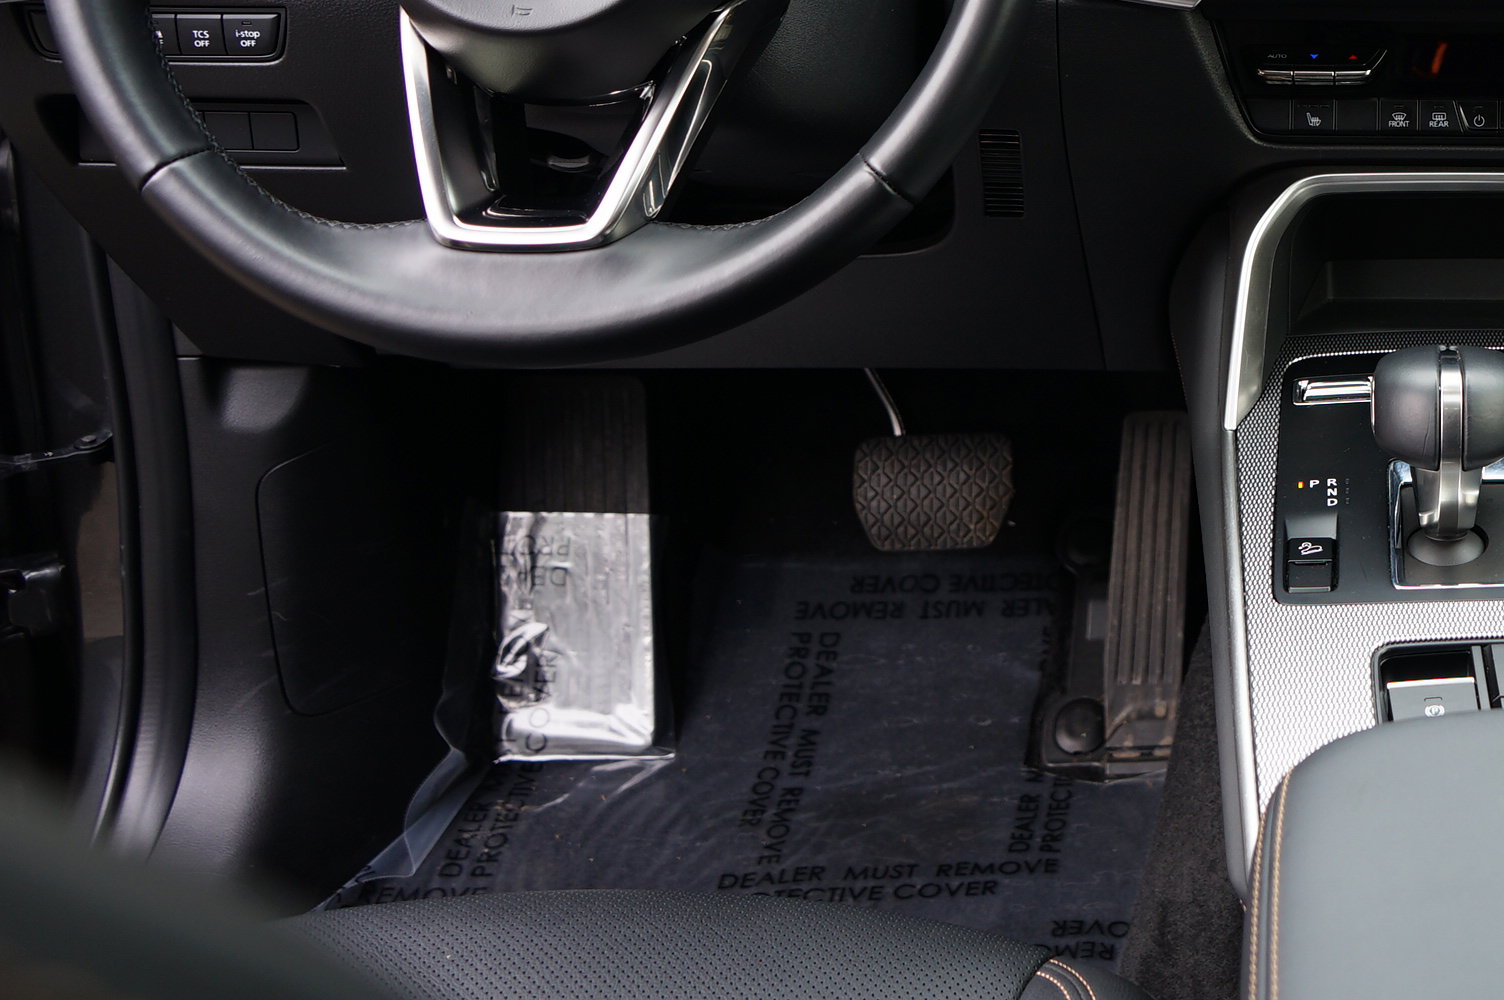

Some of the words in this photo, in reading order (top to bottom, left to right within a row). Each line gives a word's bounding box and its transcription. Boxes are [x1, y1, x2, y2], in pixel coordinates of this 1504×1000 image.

[192, 30, 210, 39] TCS
[235, 29, 261, 39] i-stop
[1388, 120, 1410, 128] FRONT
[1429, 120, 1449, 128] REAR
[1309, 479, 1319, 488] P
[1327, 478, 1337, 486] R
[1327, 488, 1337, 496] N
[1327, 498, 1338, 506] D
[851, 573, 940, 594] COVER
[794, 600, 904, 621] REMOVE
[918, 599, 985, 620] MUST
[805, 631, 842, 717] DEALER
[763, 631, 812, 761] PROTECTIVE
[788, 729, 821, 777] MUST
[738, 766, 780, 828] COVER
[758, 787, 804, 865] REMOVE
[1008, 794, 1042, 853] DEALER
[438, 800, 491, 878] DEALER
[717, 866, 826, 890] DEALER
[844, 863, 920, 881] MUST
[935, 858, 1060, 878] REMOVE
[894, 880, 998, 900] COVER
[1051, 920, 1130, 938] OVER
